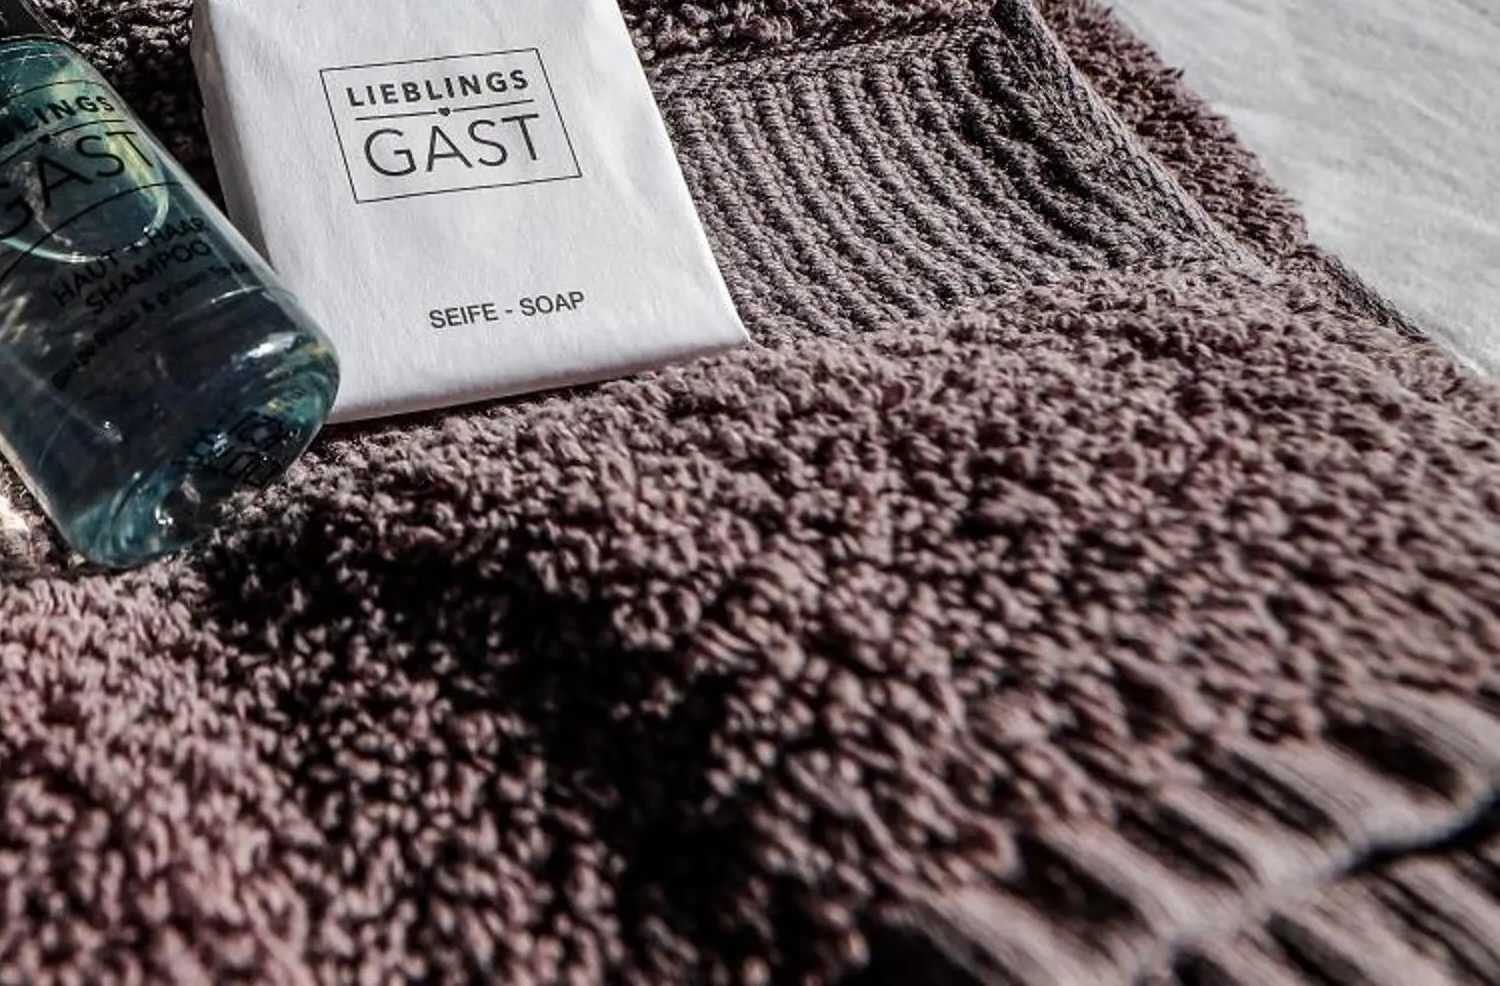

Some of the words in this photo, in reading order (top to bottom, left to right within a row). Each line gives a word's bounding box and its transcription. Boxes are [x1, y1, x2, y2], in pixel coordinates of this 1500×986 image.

[345, 69, 529, 107] LIEBLINGS
[363, 113, 540, 177] GAST
[51, 248, 119, 307] HAUT
[85, 239, 212, 315] SHAMPOO
[429, 300, 499, 330] SEIFE
[518, 290, 586, 316] SOAP
